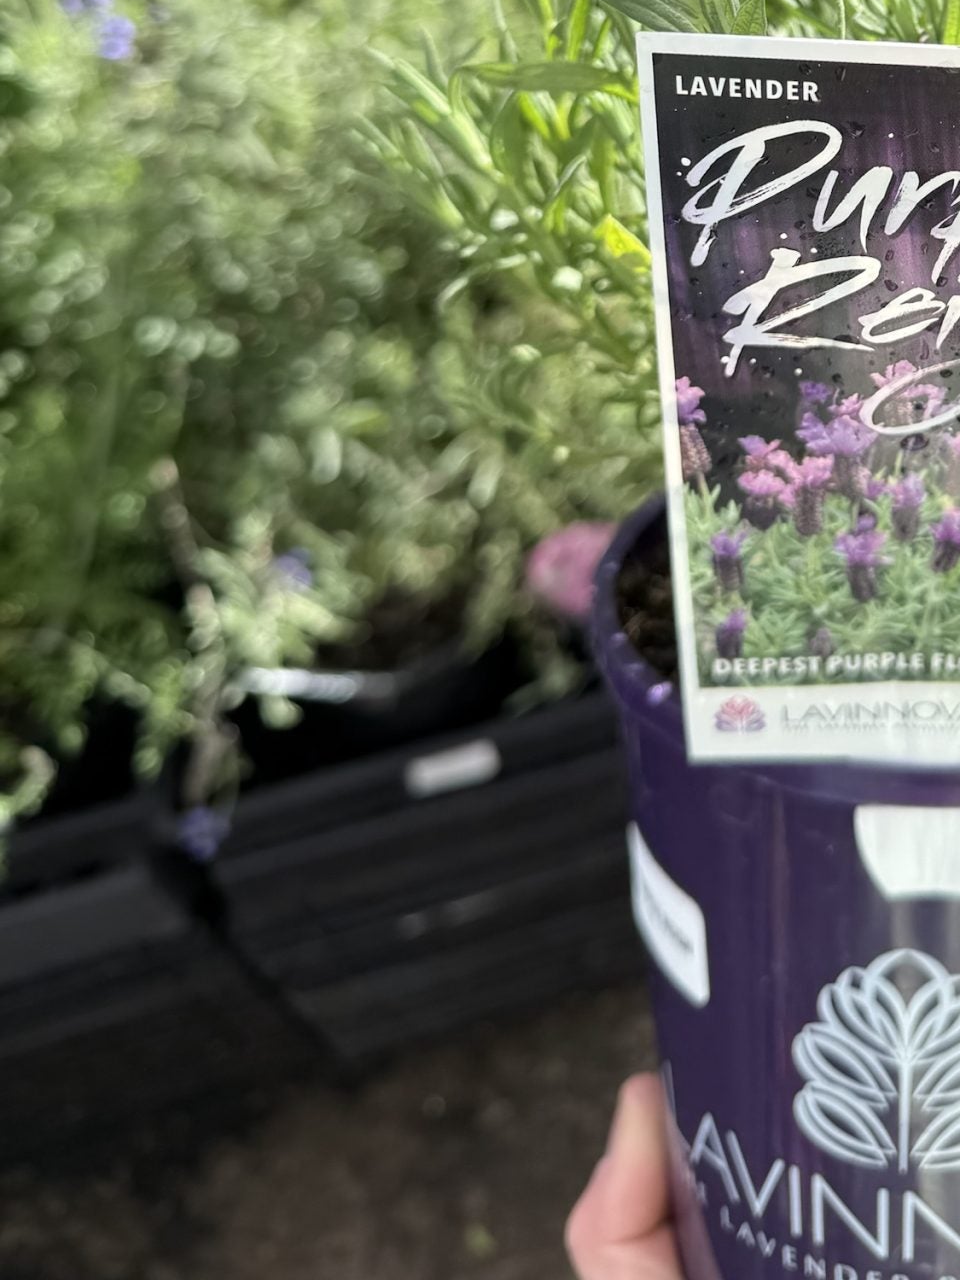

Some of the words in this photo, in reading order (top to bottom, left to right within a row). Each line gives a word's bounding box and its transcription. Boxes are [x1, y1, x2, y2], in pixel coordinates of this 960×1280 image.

[675, 75, 820, 102] LAVENDER
[713, 654, 821, 677] DEEPEST
[826, 651, 925, 673] PURPLE
